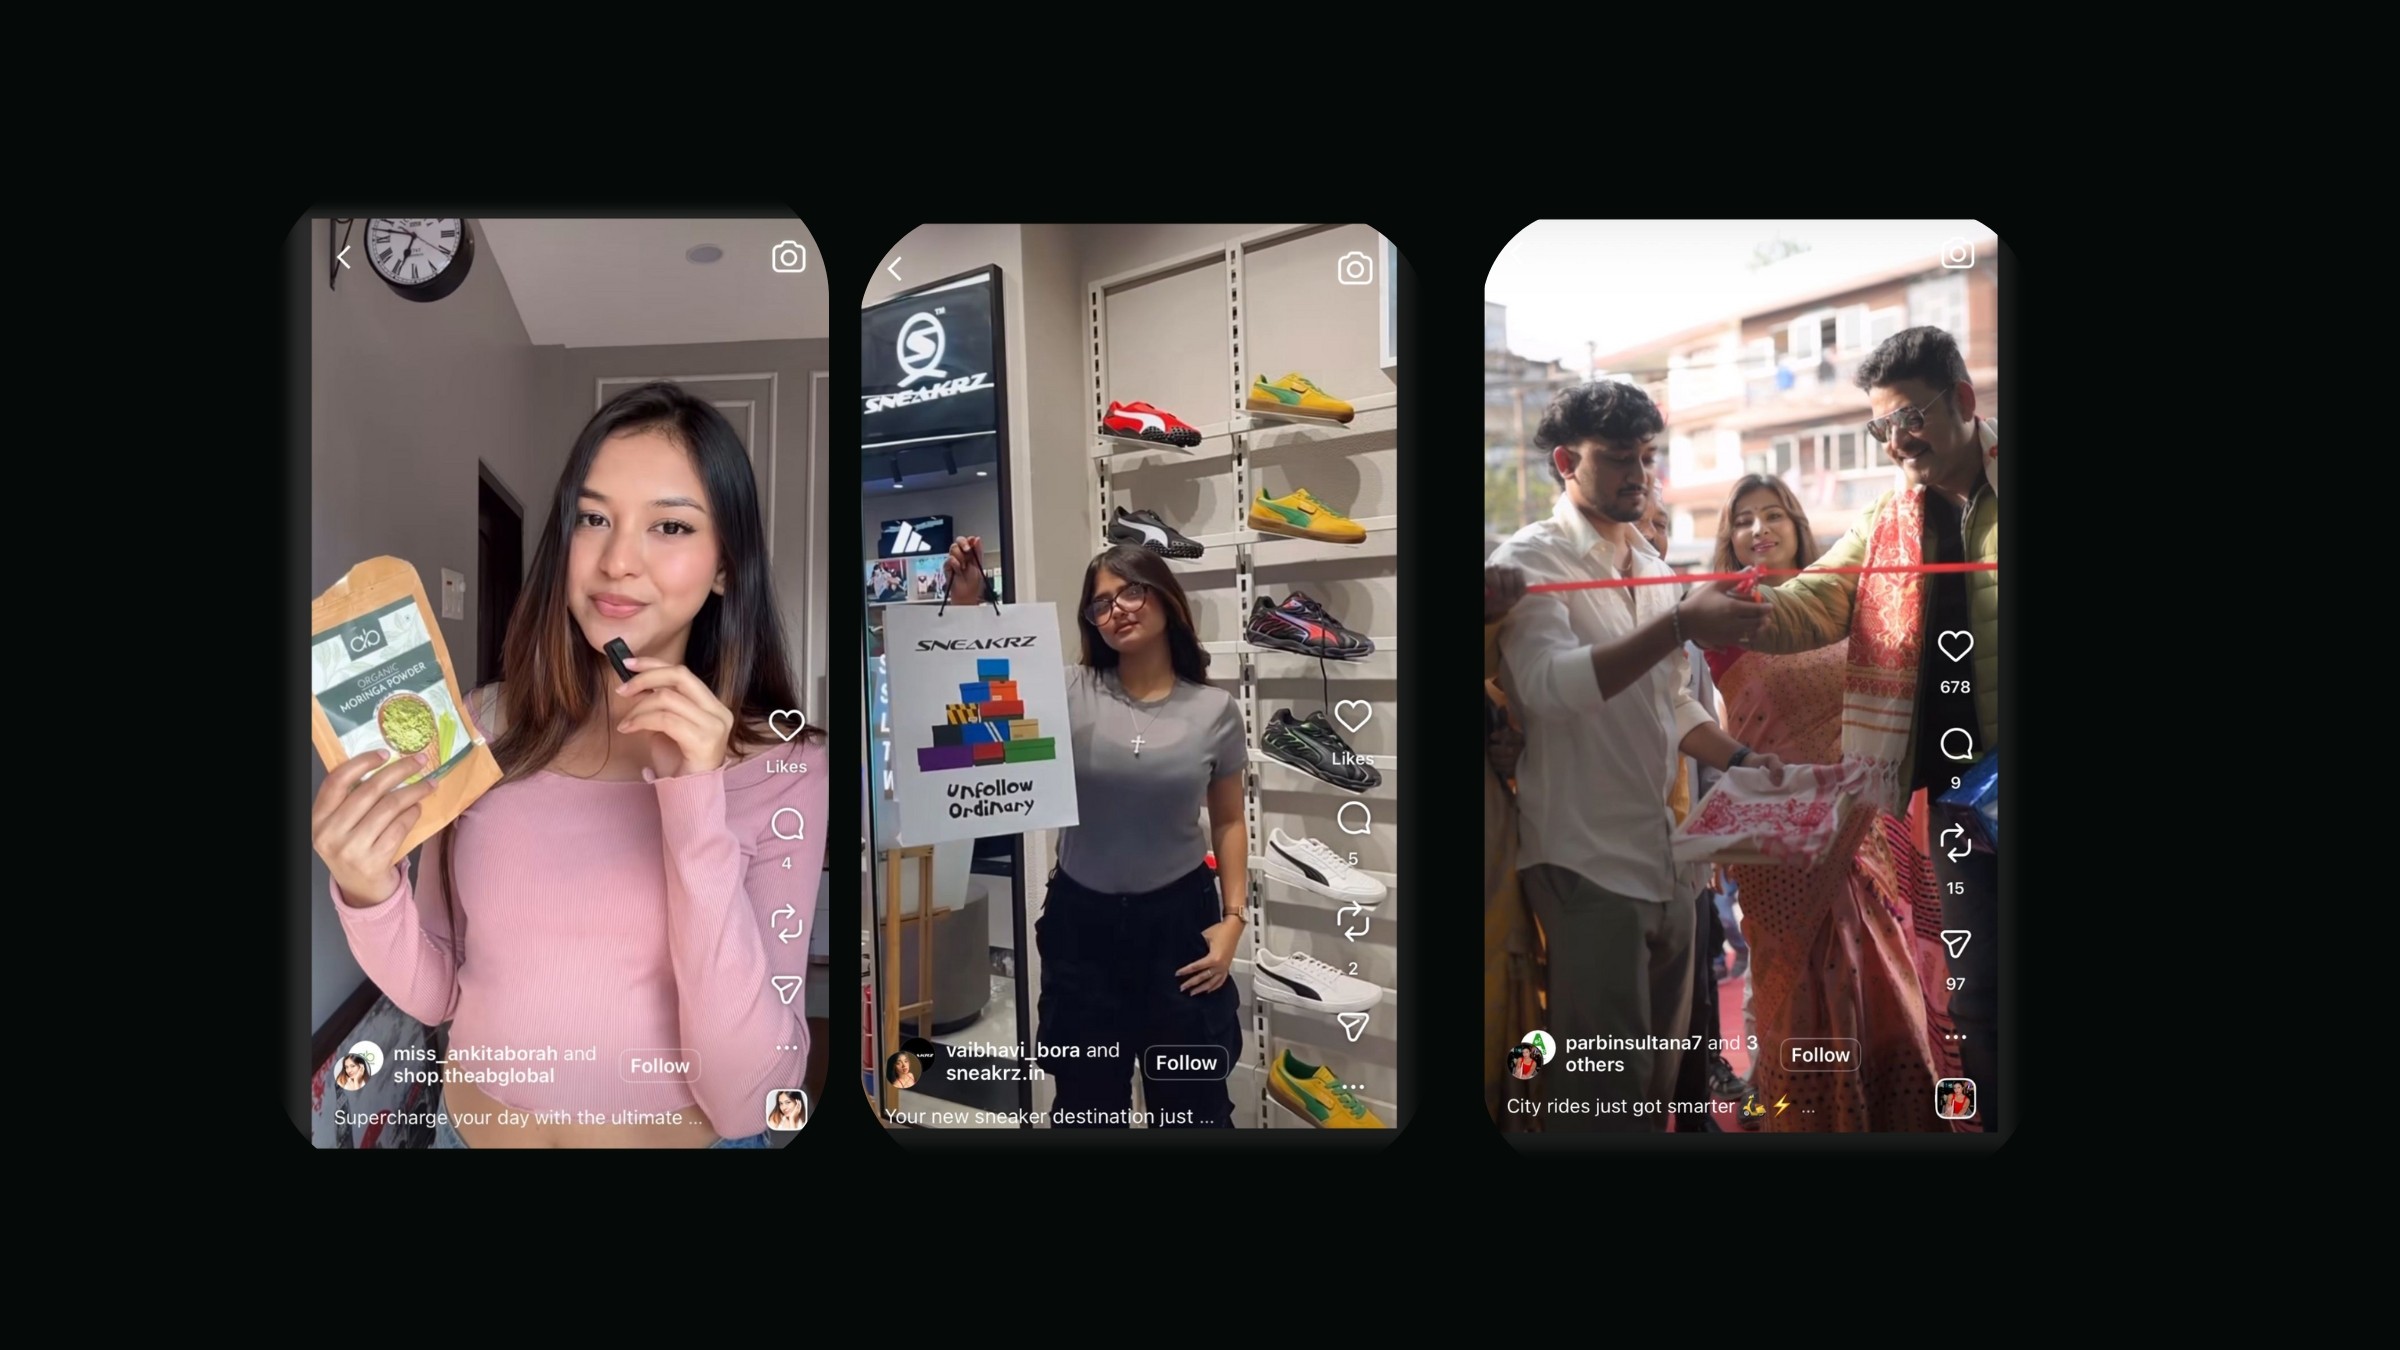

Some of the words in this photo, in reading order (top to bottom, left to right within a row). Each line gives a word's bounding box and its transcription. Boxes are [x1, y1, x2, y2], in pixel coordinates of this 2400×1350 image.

[862, 372, 994, 414] SNEAKRZ
[915, 636, 1037, 652] SNEAKRZ
[339, 684, 388, 714] MORINGA
[387, 661, 427, 688] POWDER
[357, 662, 400, 689] ORGANIC
